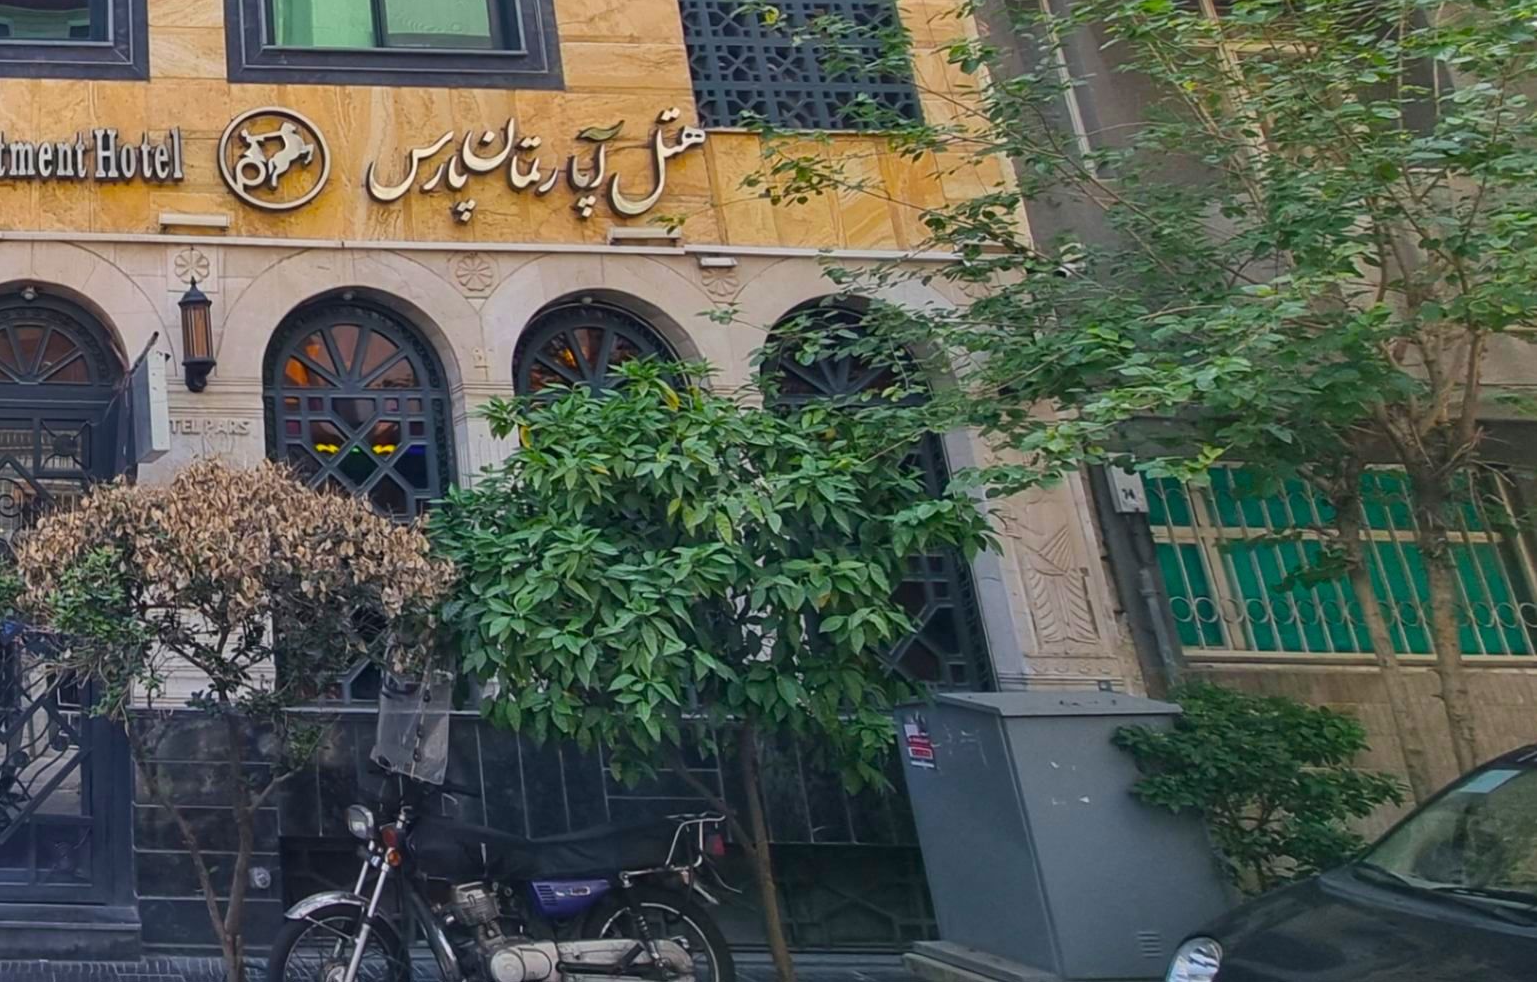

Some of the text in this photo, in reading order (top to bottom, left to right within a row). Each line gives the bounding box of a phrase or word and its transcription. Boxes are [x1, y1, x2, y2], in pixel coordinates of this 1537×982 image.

[93, 127, 184, 182] Hotel
[366, 107, 705, 223] هتل آپارتمان پارس
[169, 420, 250, 436] TEL PARS
